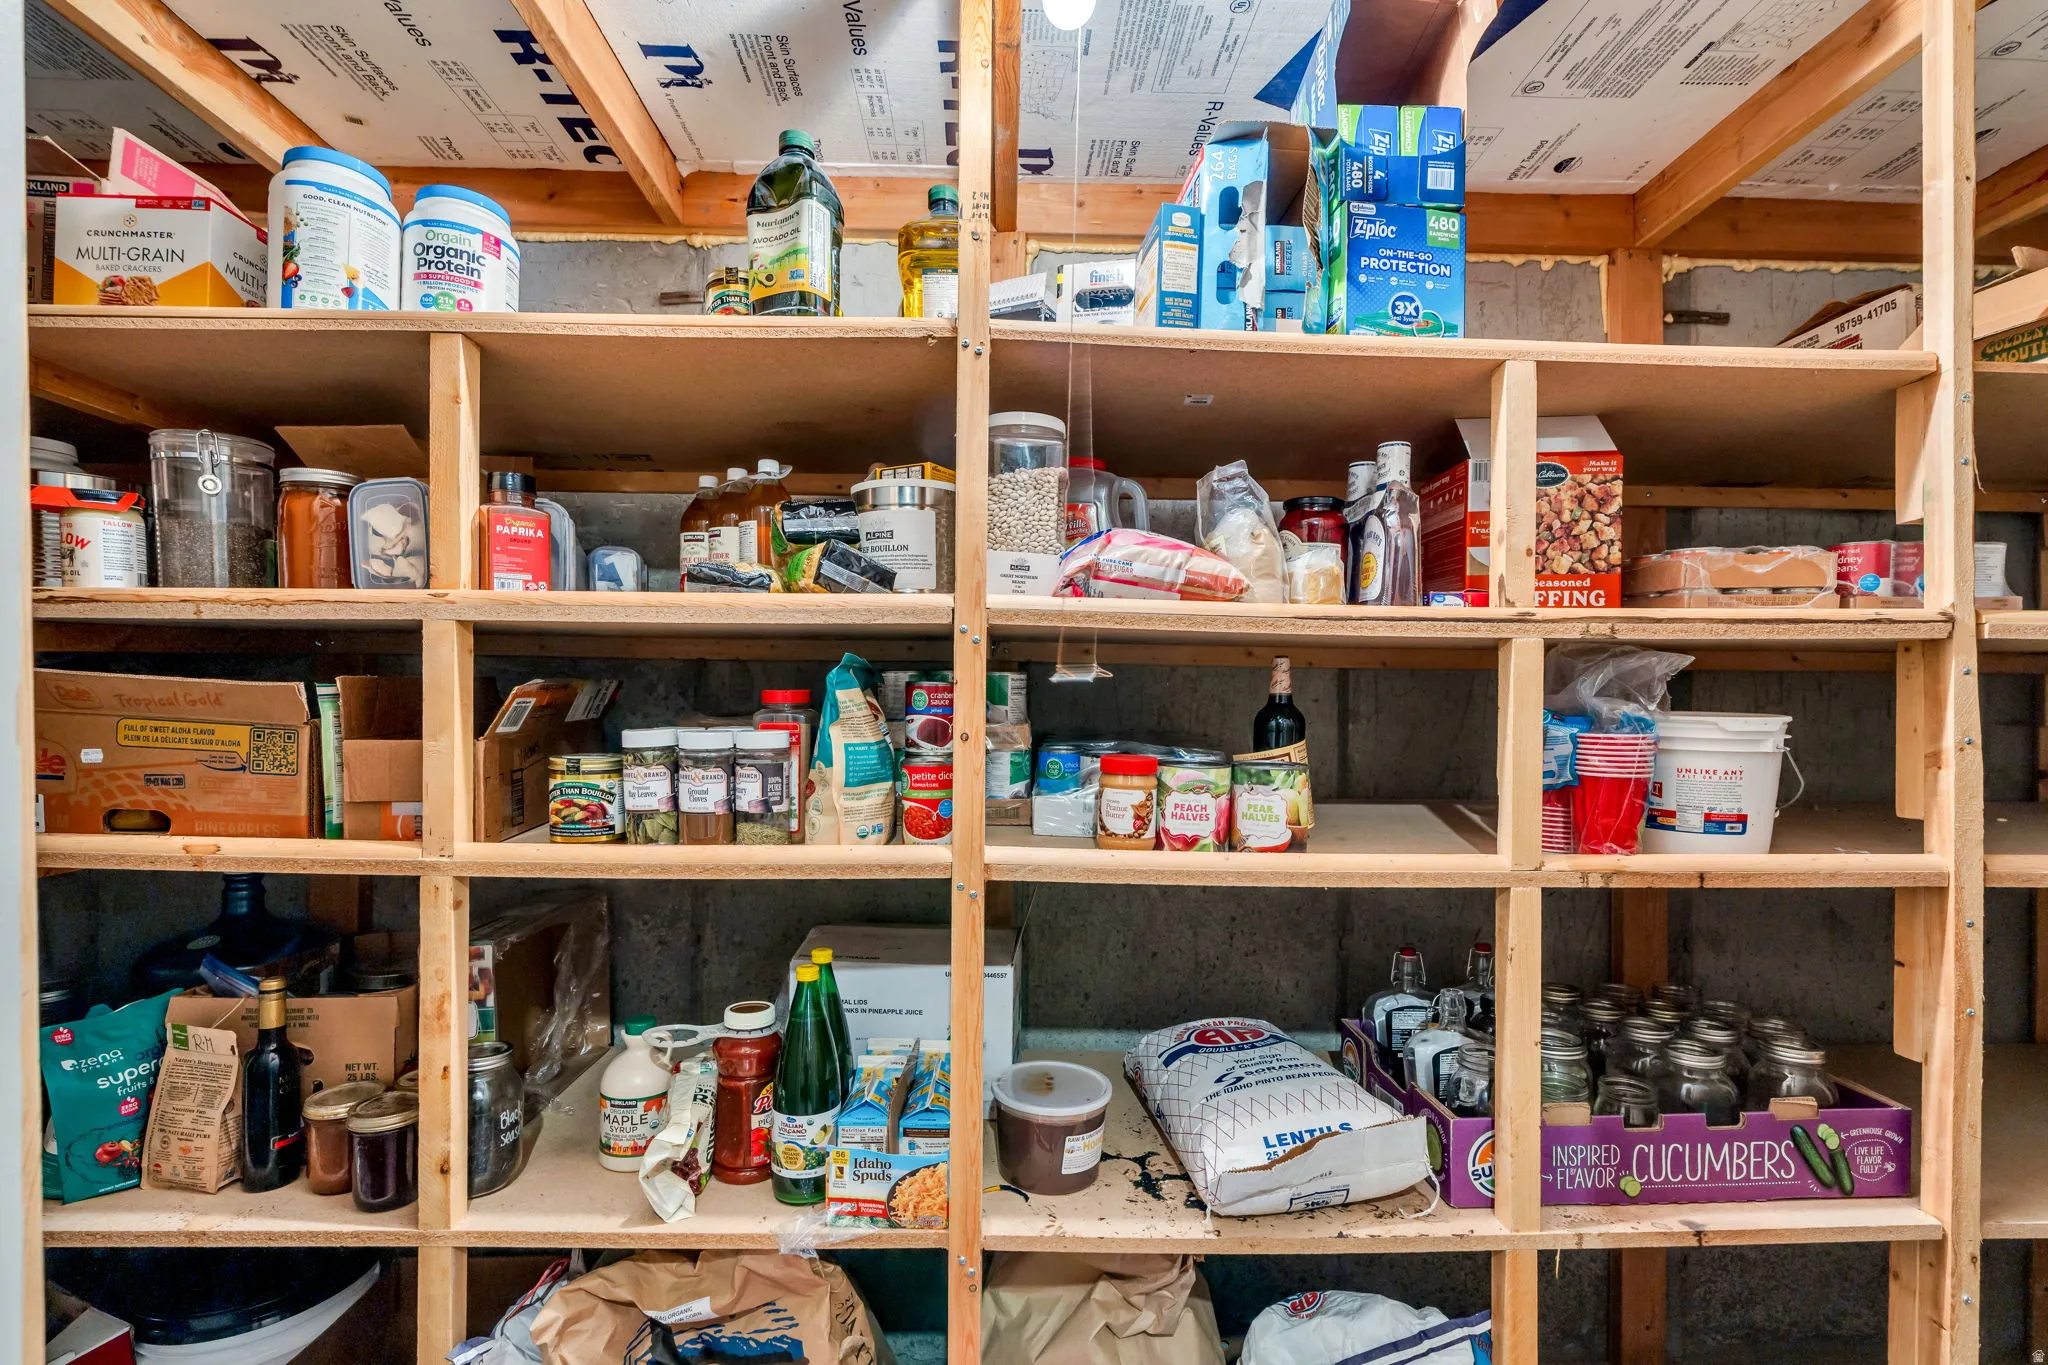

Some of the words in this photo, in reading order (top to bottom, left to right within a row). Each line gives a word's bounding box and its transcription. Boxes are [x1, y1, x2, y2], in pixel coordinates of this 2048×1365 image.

[843, 0, 868, 56] Values
[761, 35, 777, 60] Front
[776, 35, 791, 56] Skin
[313, 24, 346, 58] Front
[343, 53, 364, 74] and
[361, 73, 391, 97] Back
[330, 24, 356, 48] Skin
[355, 50, 399, 91] Surfaces
[769, 62, 784, 79] and
[783, 58, 803, 97] Surfaces
[775, 81, 791, 102] Back
[1189, 101, 1224, 156] R-Values
[1118, 140, 1127, 159] Front
[1131, 140, 1141, 157] Skin
[1208, 150, 1225, 182] 264
[1227, 147, 1238, 180] BAGS
[1351, 161, 1363, 188] 480
[1374, 170, 1385, 180] 4
[302, 193, 326, 204] GOOD,
[328, 198, 352, 209] CLEAN
[353, 205, 386, 226] NUTRITION
[756, 210, 800, 229] Marianne's
[1429, 215, 1459, 231] 480
[86, 229, 174, 240] CRUNCHMASTER
[752, 231, 783, 245] AVOCADO
[784, 227, 801, 240] OIL
[1354, 219, 1397, 240] Ziploc
[1429, 231, 1459, 239] SANDWICH
[425, 229, 472, 248] Orgain
[76, 246, 185, 264] MULTI-GRAIN
[413, 241, 487, 267] Organic
[1378, 248, 1433, 261] ON-THE-GO
[95, 264, 121, 272] BAKED
[122, 264, 162, 273] CRACKERS
[416, 257, 481, 279] Protein
[1360, 256, 1451, 277] PROTECTION
[428, 273, 475, 287] SUPERFOODS
[1089, 269, 1125, 283] finish
[722, 296, 740, 305] THAN
[1394, 301, 1418, 316] 3X
[1834, 298, 1898, 335] 18759-41705
[102, 520, 133, 528] TALLOW
[504, 516, 537, 528] Organic
[495, 525, 544, 538] PAPRIKA
[867, 531, 893, 540] ALPINE
[870, 544, 909, 553] BOUILLON
[1534, 578, 1591, 588] Seasoned
[114, 692, 181, 711] Tropical
[184, 693, 221, 708] Gold
[124, 724, 139, 732] FULL
[171, 727, 191, 735] ALOHA
[911, 772, 937, 783] petite
[938, 771, 953, 780] dice
[1676, 767, 1719, 776] UNLIKE
[637, 790, 657, 798] Leaves
[687, 787, 709, 796] Ground
[768, 783, 781, 791] PURE
[561, 787, 580, 795] THAN
[581, 787, 616, 802] BOUILLON
[688, 795, 708, 803] Cloves
[1105, 803, 1128, 813] Peanut
[1105, 810, 1126, 820] Butter
[1173, 803, 1208, 813] PEACH
[1247, 803, 1274, 814] PEAR
[1170, 811, 1210, 822] HALVES
[1241, 812, 1281, 823] HALVES
[194, 820, 281, 836] PINEAPPLES
[1201, 1020, 1225, 1028] BEAN
[1198, 1045, 1236, 1053] DOUBLE
[80, 1049, 122, 1068] zena
[1233, 1055, 1256, 1064] Your
[1258, 1052, 1281, 1062] Sign
[1238, 1060, 1273, 1070] Quality
[345, 1063, 364, 1072] NET
[366, 1062, 380, 1071] WT.
[347, 1073, 358, 1082] 25
[360, 1072, 380, 1082] LBS.
[117, 1081, 147, 1096] fruits
[1205, 1091, 1222, 1102] THE
[1223, 1082, 1253, 1094] IDAHO
[1255, 1076, 1284, 1087] PINTO
[1285, 1072, 1311, 1080] BEAN
[120, 1101, 138, 1110] ZERO
[603, 1112, 649, 1126] MAPLE
[780, 1121, 804, 1129] ITALIAN
[609, 1125, 638, 1134] SYRUP
[778, 1126, 807, 1135] VOLCANO
[1262, 1122, 1353, 1149] LENTILS
[1849, 1127, 1883, 1136] GREENHOUSE
[1884, 1130, 1904, 1145] GROWN
[1265, 1150, 1280, 1161] 25
[1552, 1144, 1621, 1167] INSPIRED
[1854, 1146, 1868, 1155] LIVE
[1870, 1146, 1885, 1155] LIFE
[854, 1157, 892, 1170] Idaho
[1632, 1141, 1796, 1183] CUCUMBERS
[1856, 1156, 1882, 1164] FLAVOR
[852, 1169, 892, 1184] Spuds
[1859, 1165, 1880, 1174] FULLY
[1557, 1168, 1616, 1190] FLAVOR
[668, 1305, 693, 1319] ORGANIC
